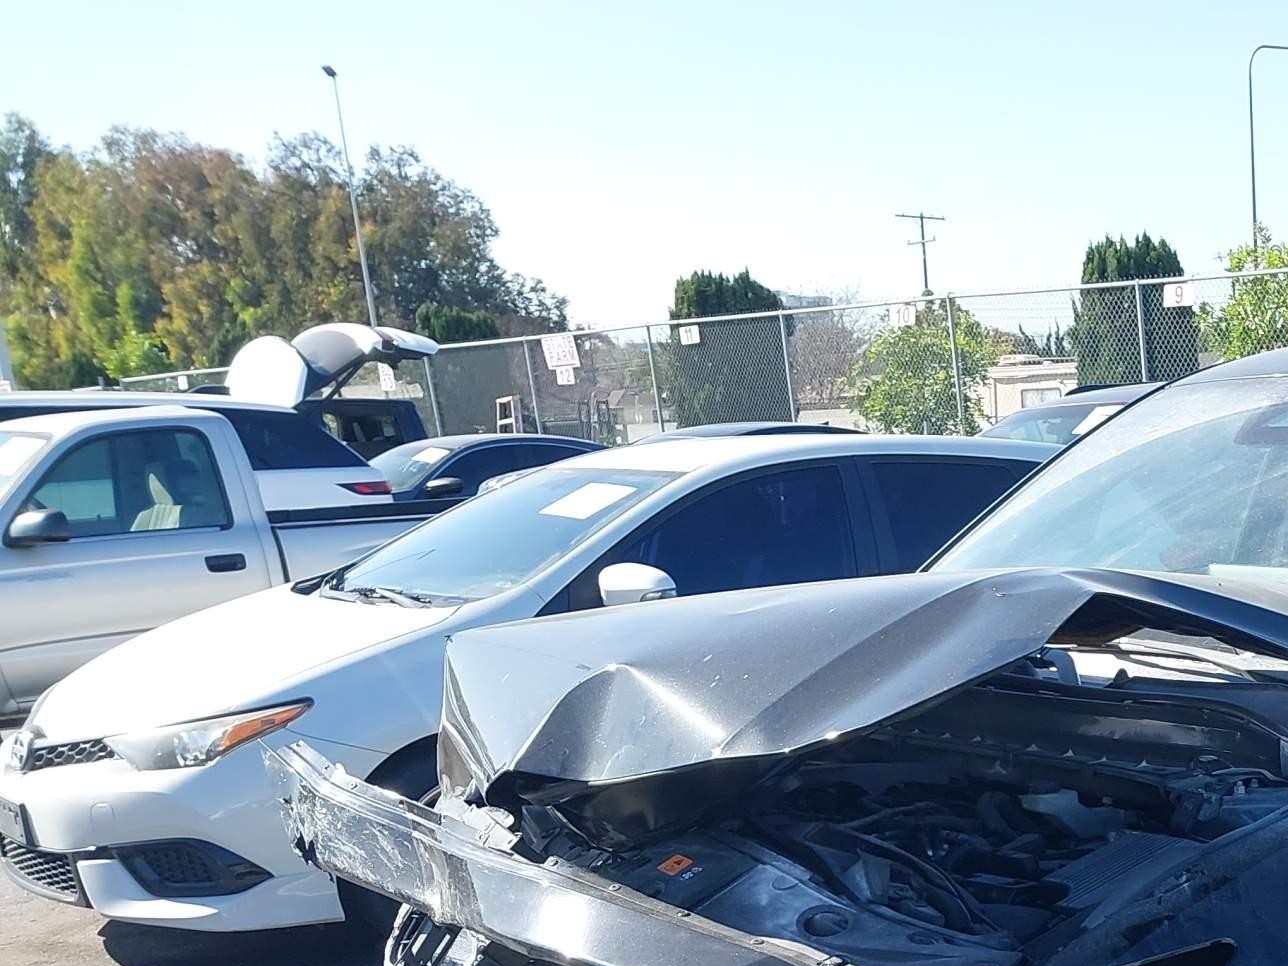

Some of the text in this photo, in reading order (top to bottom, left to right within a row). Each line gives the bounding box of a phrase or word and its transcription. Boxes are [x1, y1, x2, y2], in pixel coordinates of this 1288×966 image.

[1175, 285, 1184, 304] 9
[895, 306, 910, 323] 10
[684, 327, 693, 343] 11
[548, 348, 577, 364] FARM
[559, 368, 573, 383] 12
